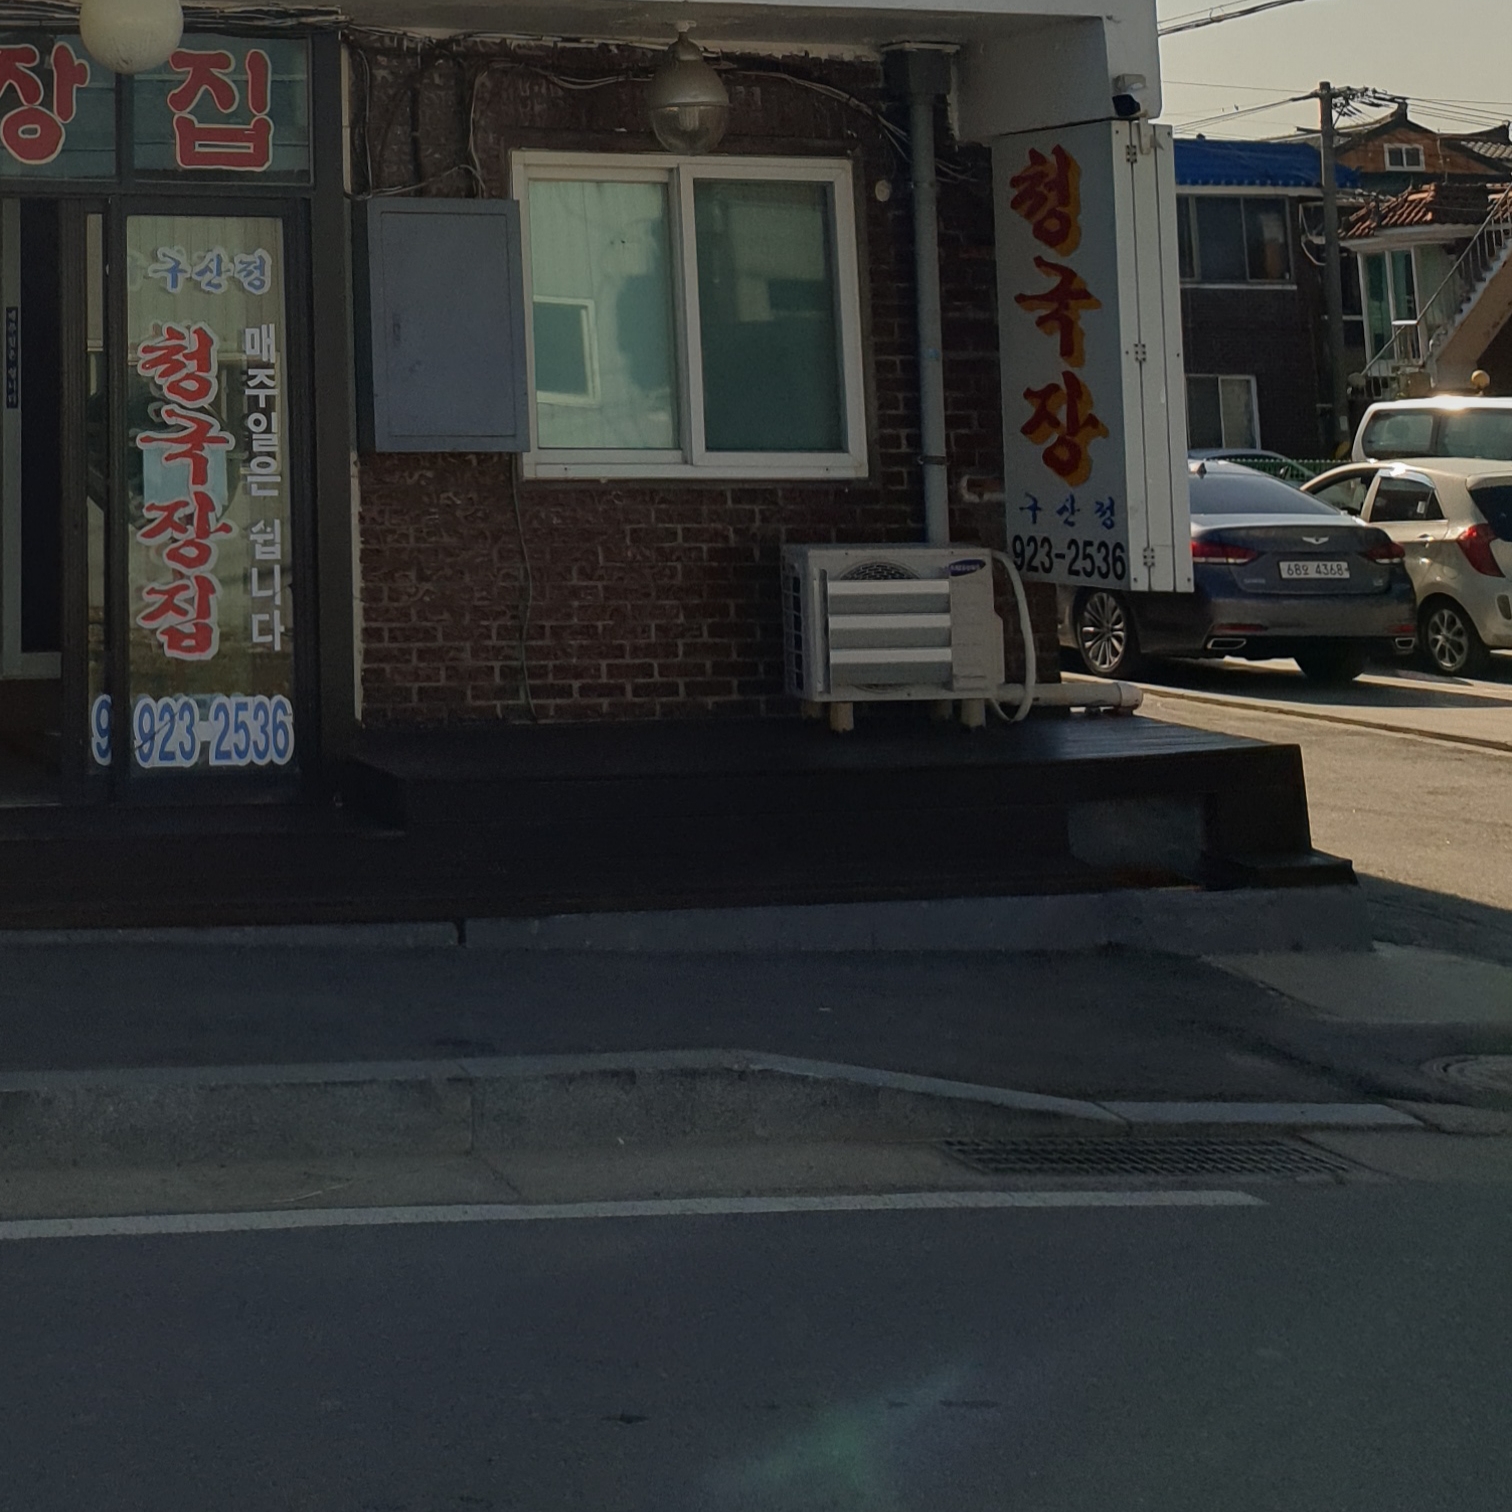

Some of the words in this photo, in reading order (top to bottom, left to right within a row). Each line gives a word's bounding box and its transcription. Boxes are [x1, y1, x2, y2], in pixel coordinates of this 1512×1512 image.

[149, 248, 271, 293] 구산정
[1009, 143, 1111, 488] 청국장
[242, 323, 282, 497] 매주일은
[137, 324, 233, 658] 청국장집
[1019, 492, 1117, 531] 구산정
[248, 518, 286, 653] 쉽니다
[1011, 534, 1127, 582] 923-2536
[1315, 563, 1344, 576] 4368
[136, 695, 291, 765] 923-2536
